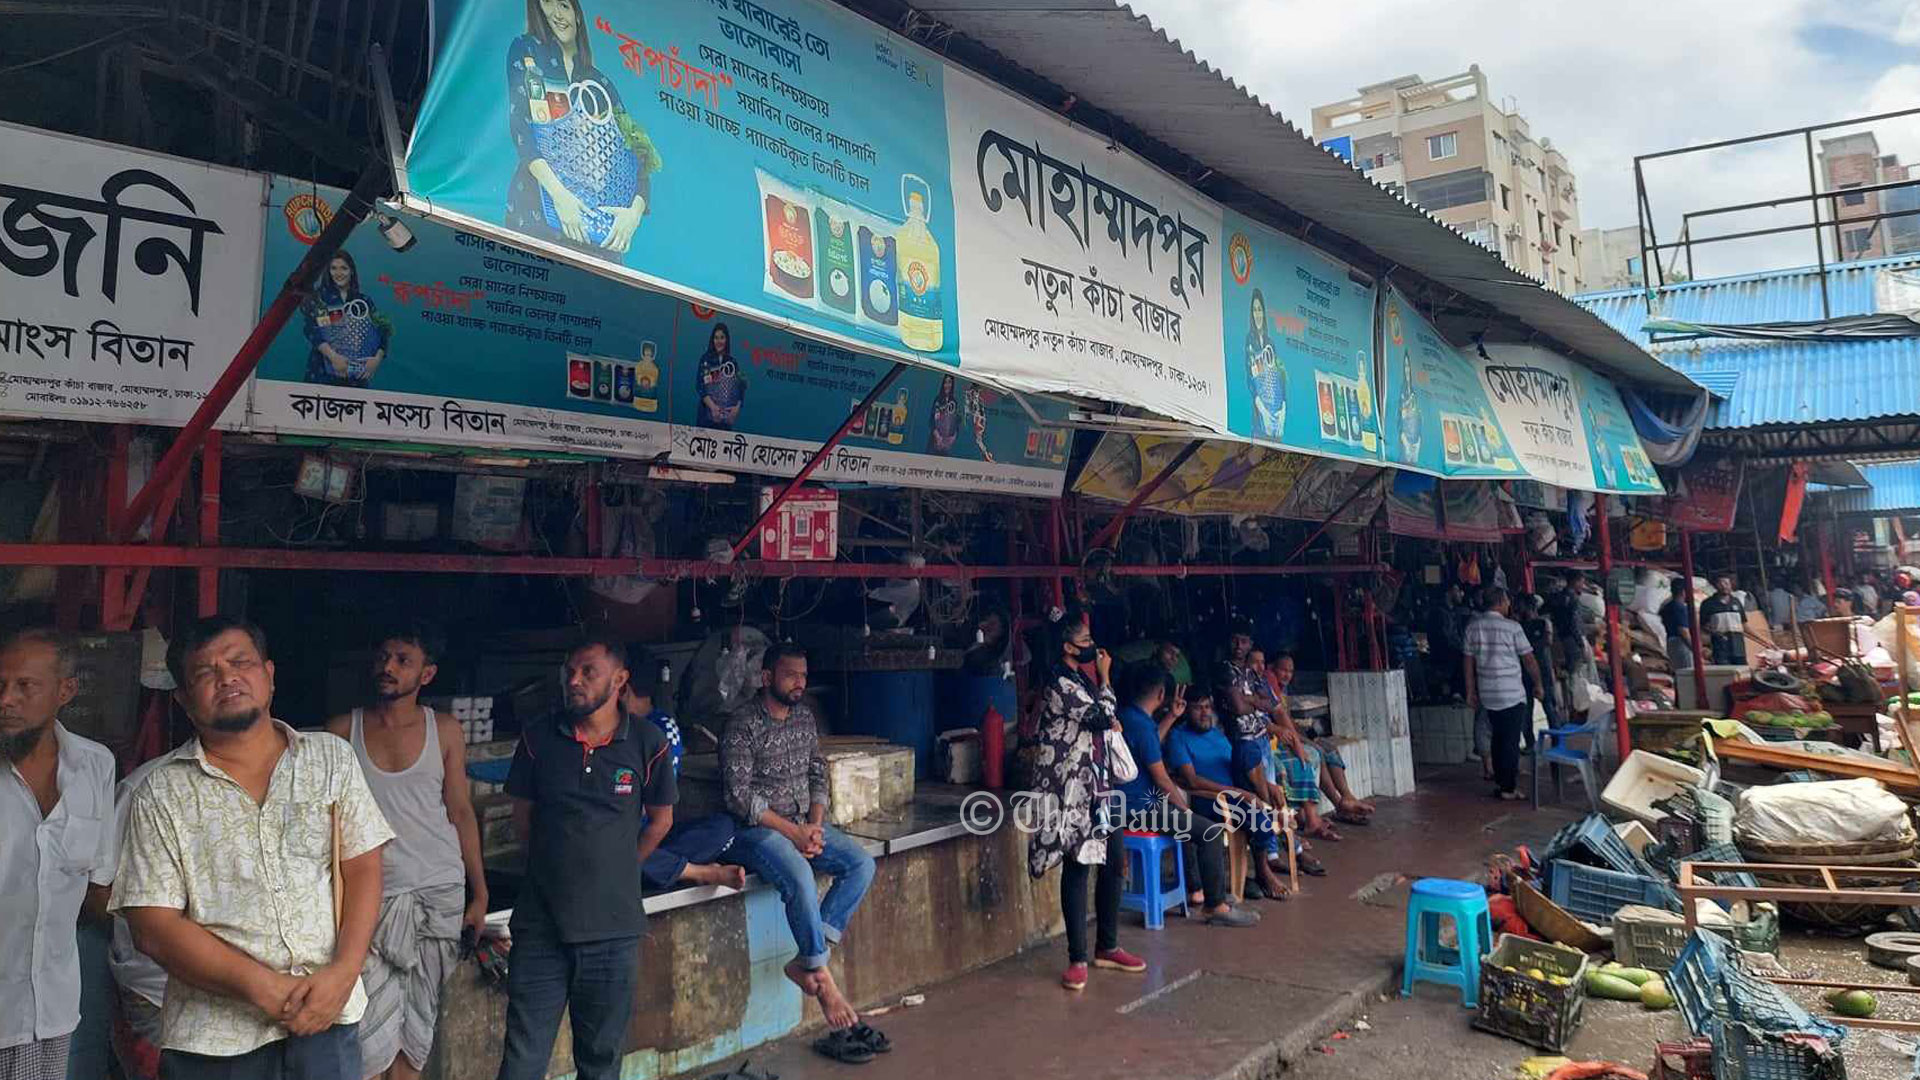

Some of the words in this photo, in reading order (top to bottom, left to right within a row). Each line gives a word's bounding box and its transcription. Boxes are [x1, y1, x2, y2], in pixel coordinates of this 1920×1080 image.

[718, 16, 802, 75] ভালোবাসা
[804, 32, 830, 61] তো
[699, 44, 728, 70] সেরা
[730, 57, 768, 90] মানের
[771, 71, 830, 118] নিশ্চয়তায়
[905, 60, 932, 88] BEL
[658, 91, 700, 123] পাওয়া
[704, 109, 741, 139] যাচ্ছে
[745, 127, 809, 169] প্যাকেটকৃত
[811, 151, 847, 183] তিনটি
[849, 170, 870, 192] চাল
[736, 90, 782, 125] সয়াবিন
[785, 114, 823, 143] তেলের
[827, 132, 877, 166] পাশাপাশি
[977, 128, 1210, 310] মোহাম্মদপুর
[459, 275, 482, 290] সেরা
[483, 256, 550, 282] ভালোবাসা
[1021, 258, 1075, 318] নতুন
[1079, 265, 1125, 323] কাঁচা
[1129, 293, 1182, 345] বাজার
[87, 320, 195, 371] বিতান
[984, 318, 1040, 349] মোহাম্মদপুর
[1042, 332, 1065, 352] নতুন
[1067, 330, 1087, 353] কাঁচা
[1120, 350, 1167, 380] মোহাম্মদপুর,
[64, 378, 85, 391] কাঁচা
[289, 394, 367, 424] কাজল
[374, 401, 435, 430] মৎস্য
[442, 401, 507, 435] বিতান
[689, 436, 718, 459] মোঃ
[722, 434, 748, 463] নবী
[751, 444, 798, 467] হোসেন
[836, 448, 871, 474] বিতান
